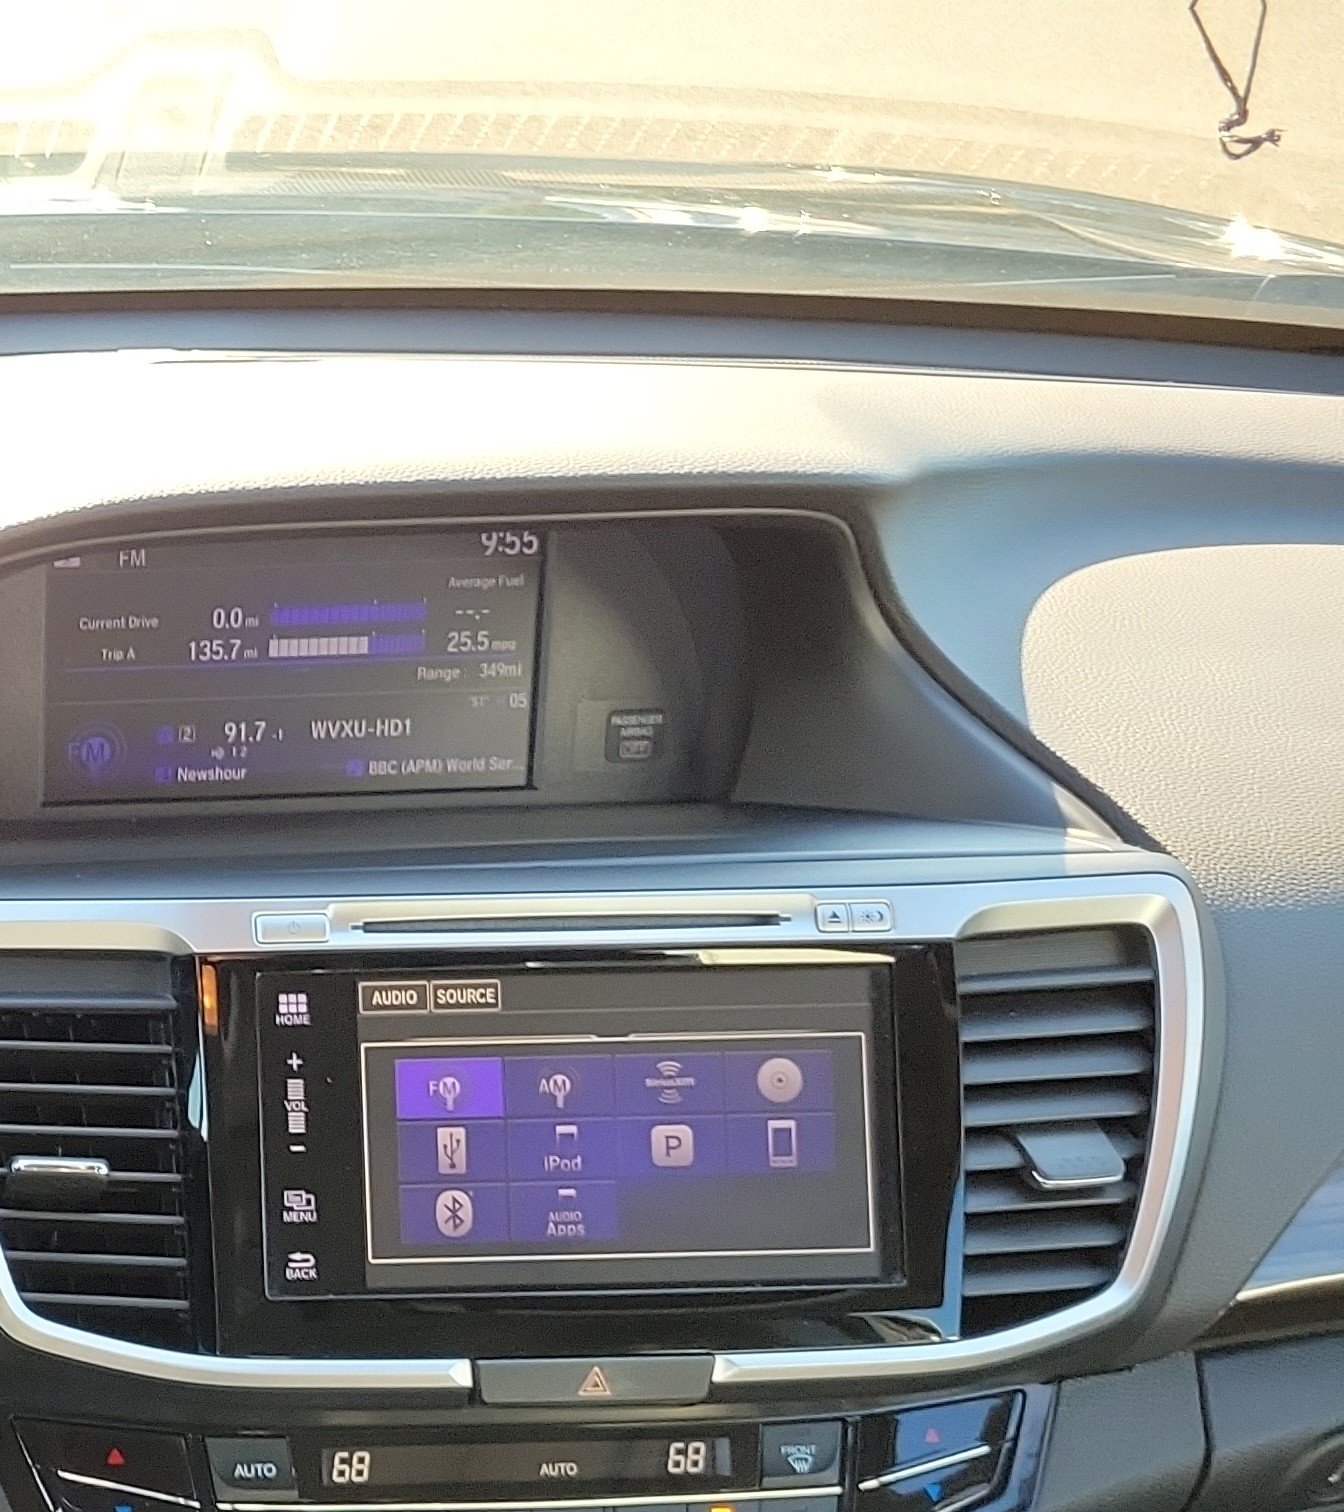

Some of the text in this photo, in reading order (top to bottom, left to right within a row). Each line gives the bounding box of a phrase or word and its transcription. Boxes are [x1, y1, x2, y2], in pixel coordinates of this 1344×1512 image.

[480, 530, 540, 557] 9:55
[118, 548, 146, 568] FM
[79, 616, 127, 631] Current
[127, 614, 159, 629] Drive
[212, 606, 243, 629] 0.0
[188, 639, 242, 662] 135.7
[446, 630, 490, 653] 25.5
[223, 720, 267, 744] 91.7
[310, 718, 412, 741] WVXU-HD1
[176, 766, 248, 783] Newshour
[371, 988, 497, 1007] AUDIO SOURCE
[275, 1013, 312, 1027] HOME
[283, 1099, 310, 1113] VOL
[543, 1154, 583, 1172] iPod
[282, 1210, 318, 1223] MENU
[285, 1268, 318, 1281] BACK
[666, 1441, 707, 1475] 68
[779, 1444, 817, 1457] FRONT
[233, 1462, 278, 1479] AUTO
[331, 1450, 371, 1484] 68
[539, 1461, 578, 1477] AUTO
